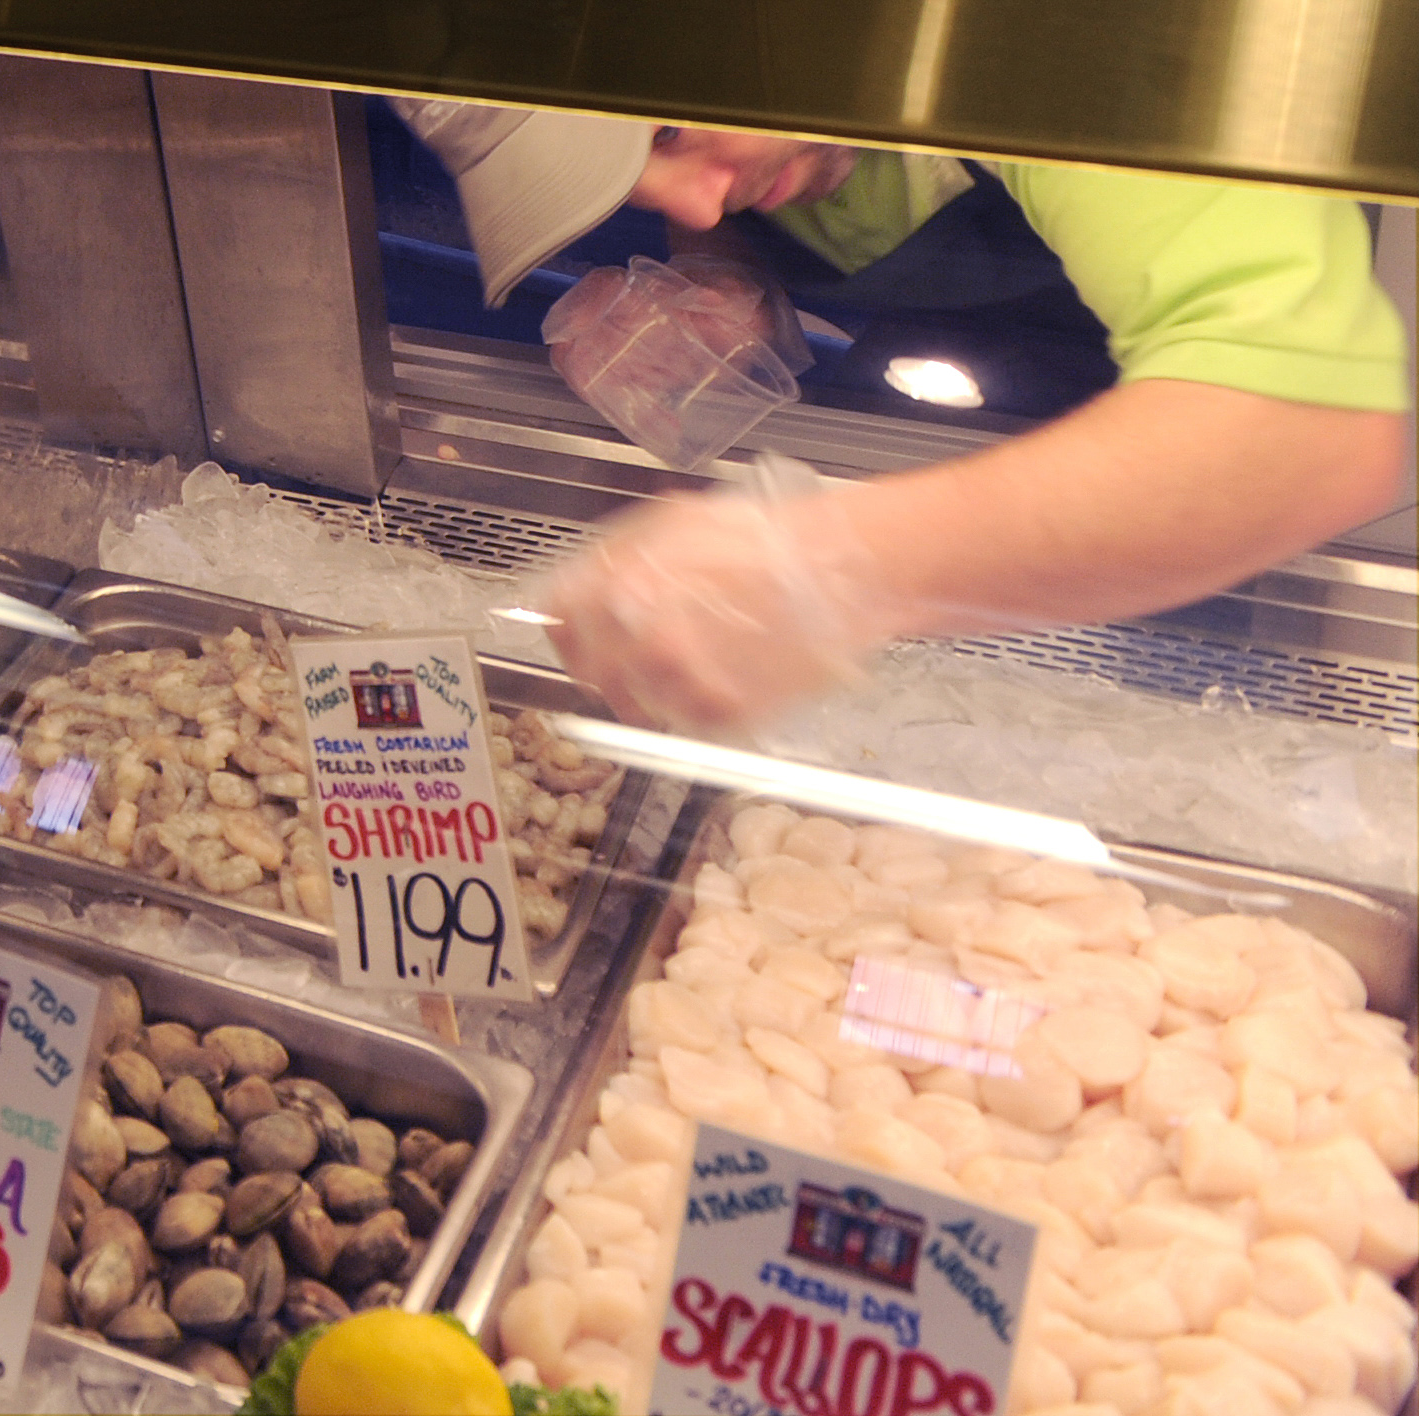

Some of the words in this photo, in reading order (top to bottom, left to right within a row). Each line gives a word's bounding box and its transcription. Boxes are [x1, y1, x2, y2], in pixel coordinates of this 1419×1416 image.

[305, 662, 341, 690] FARM
[416, 664, 478, 727] QUALITY
[429, 655, 461, 686] TOP
[304, 686, 350, 721] RAISED
[313, 736, 367, 755] FRESH
[316, 758, 376, 776] PEELED
[319, 780, 405, 802] LAUGHING
[414, 780, 462, 802] BIRD
[323, 800, 500, 865] SHRIMP
[332, 866, 506, 988] $11.99
[28, 976, 78, 1028] TOP
[6, 1005, 75, 1089] QUALITY
[693, 1148, 771, 1181] WILD
[937, 1216, 1004, 1269] ALL
[757, 1259, 851, 1315] FRESH
[861, 1292, 922, 1350] DRY
[659, 1274, 997, 1416] SCALLOPS
